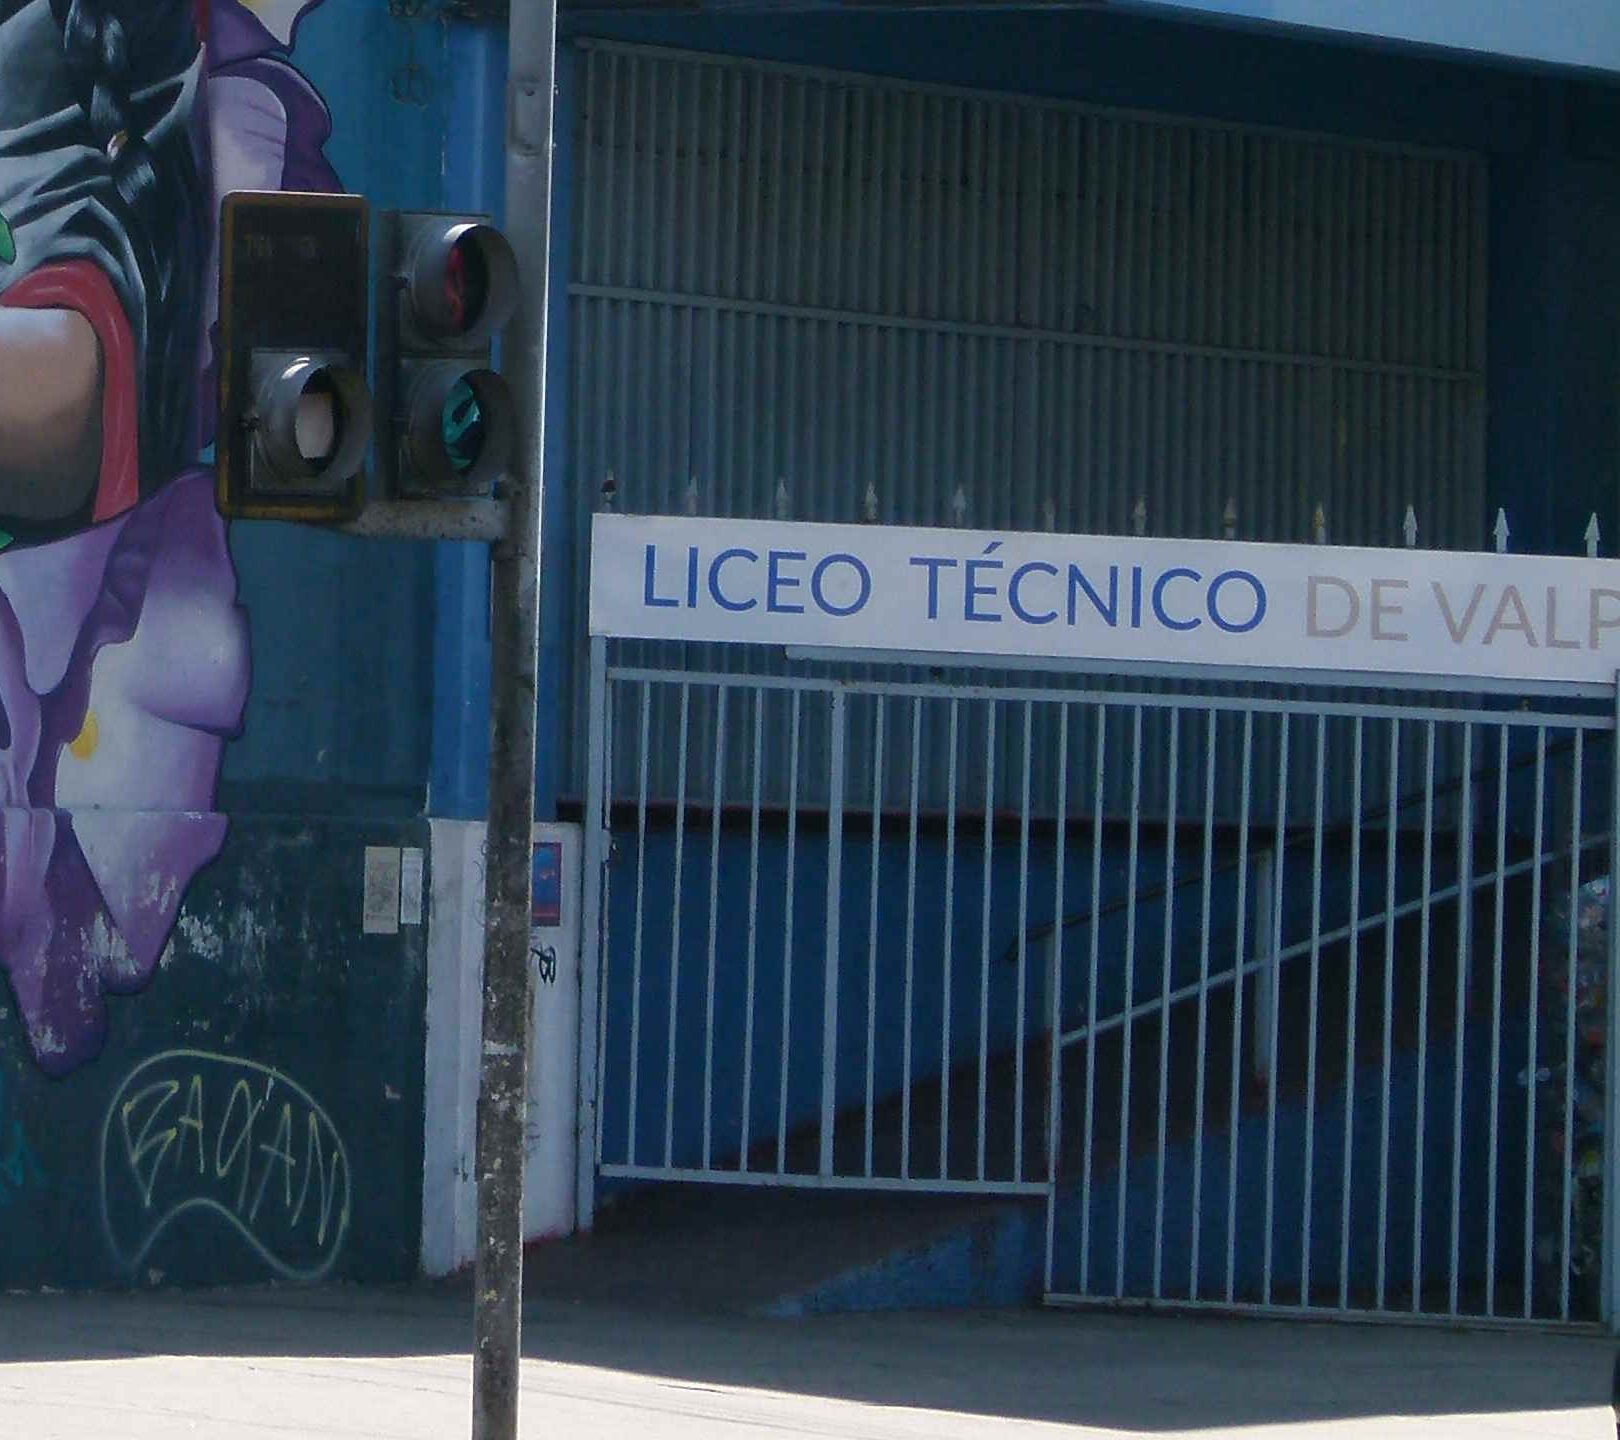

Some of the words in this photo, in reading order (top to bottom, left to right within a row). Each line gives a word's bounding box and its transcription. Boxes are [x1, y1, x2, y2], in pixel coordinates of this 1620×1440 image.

[644, 544, 871, 616] LICEO
[909, 542, 1266, 633] TÉCNICO
[1306, 575, 1409, 641] DE
[1431, 581, 1620, 650] VALP
